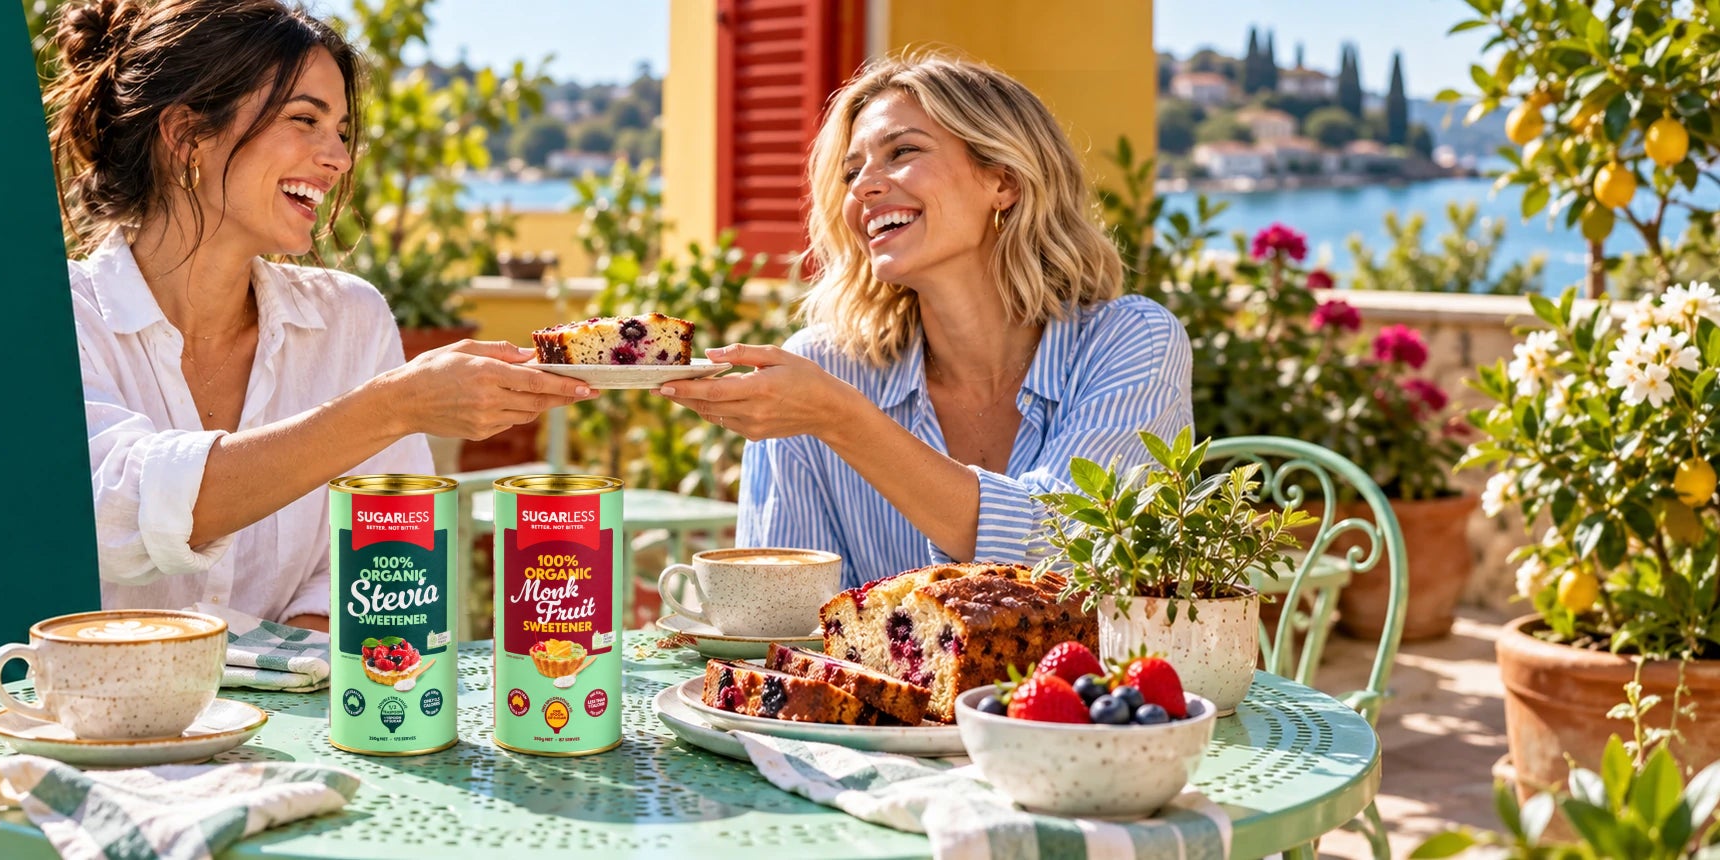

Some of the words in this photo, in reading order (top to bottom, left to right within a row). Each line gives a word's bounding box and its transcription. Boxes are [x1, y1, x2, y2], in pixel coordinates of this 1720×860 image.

[357, 511, 430, 523] SUGARLESS
[522, 510, 595, 522] SUGARLESS
[373, 556, 414, 569] 100%
[537, 555, 579, 567] 100%
[360, 569, 426, 582] ORGANIC
[524, 567, 592, 580] ORGANIC
[510, 576, 579, 603] Monk
[347, 579, 439, 617] Stevia
[536, 597, 596, 624] Fruit
[358, 614, 427, 626] SWEETENER
[523, 621, 592, 633] SWEETENER
